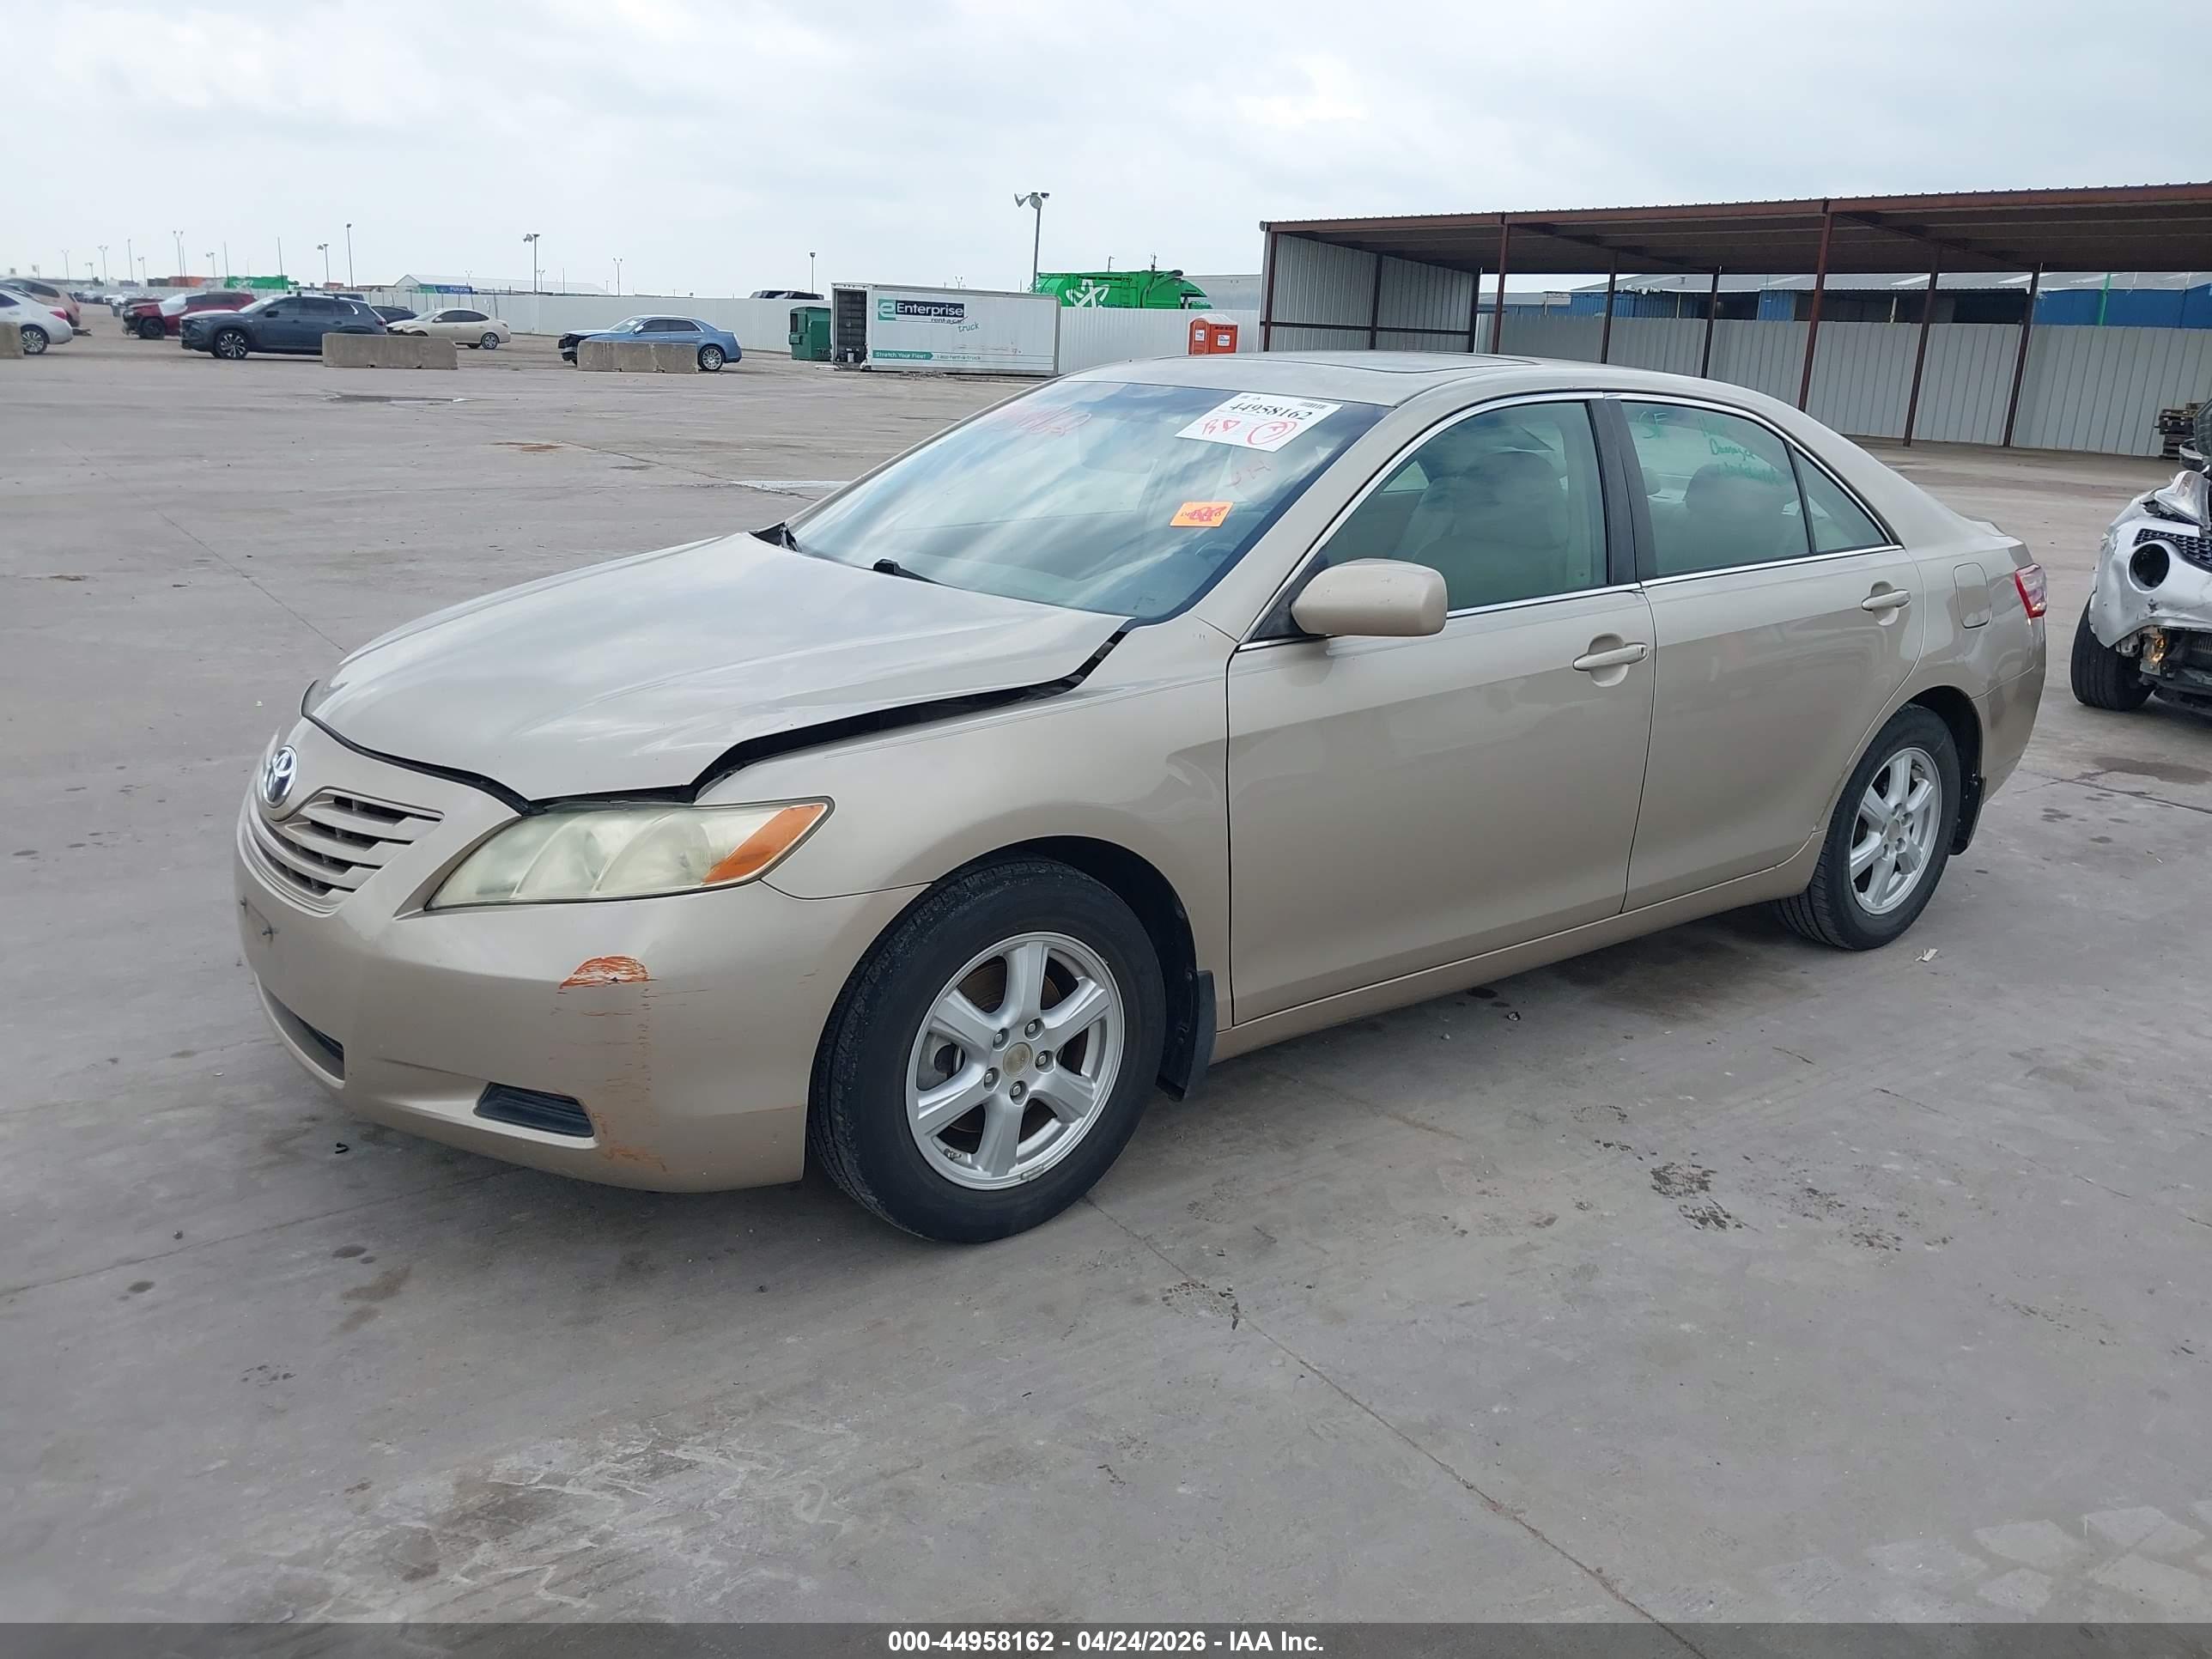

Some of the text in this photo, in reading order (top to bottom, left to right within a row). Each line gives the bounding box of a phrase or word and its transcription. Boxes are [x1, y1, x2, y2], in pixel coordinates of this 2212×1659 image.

[896, 302, 963, 318] Enterprise
[958, 322, 980, 332] truck
[1230, 403, 1313, 420] 44958162
